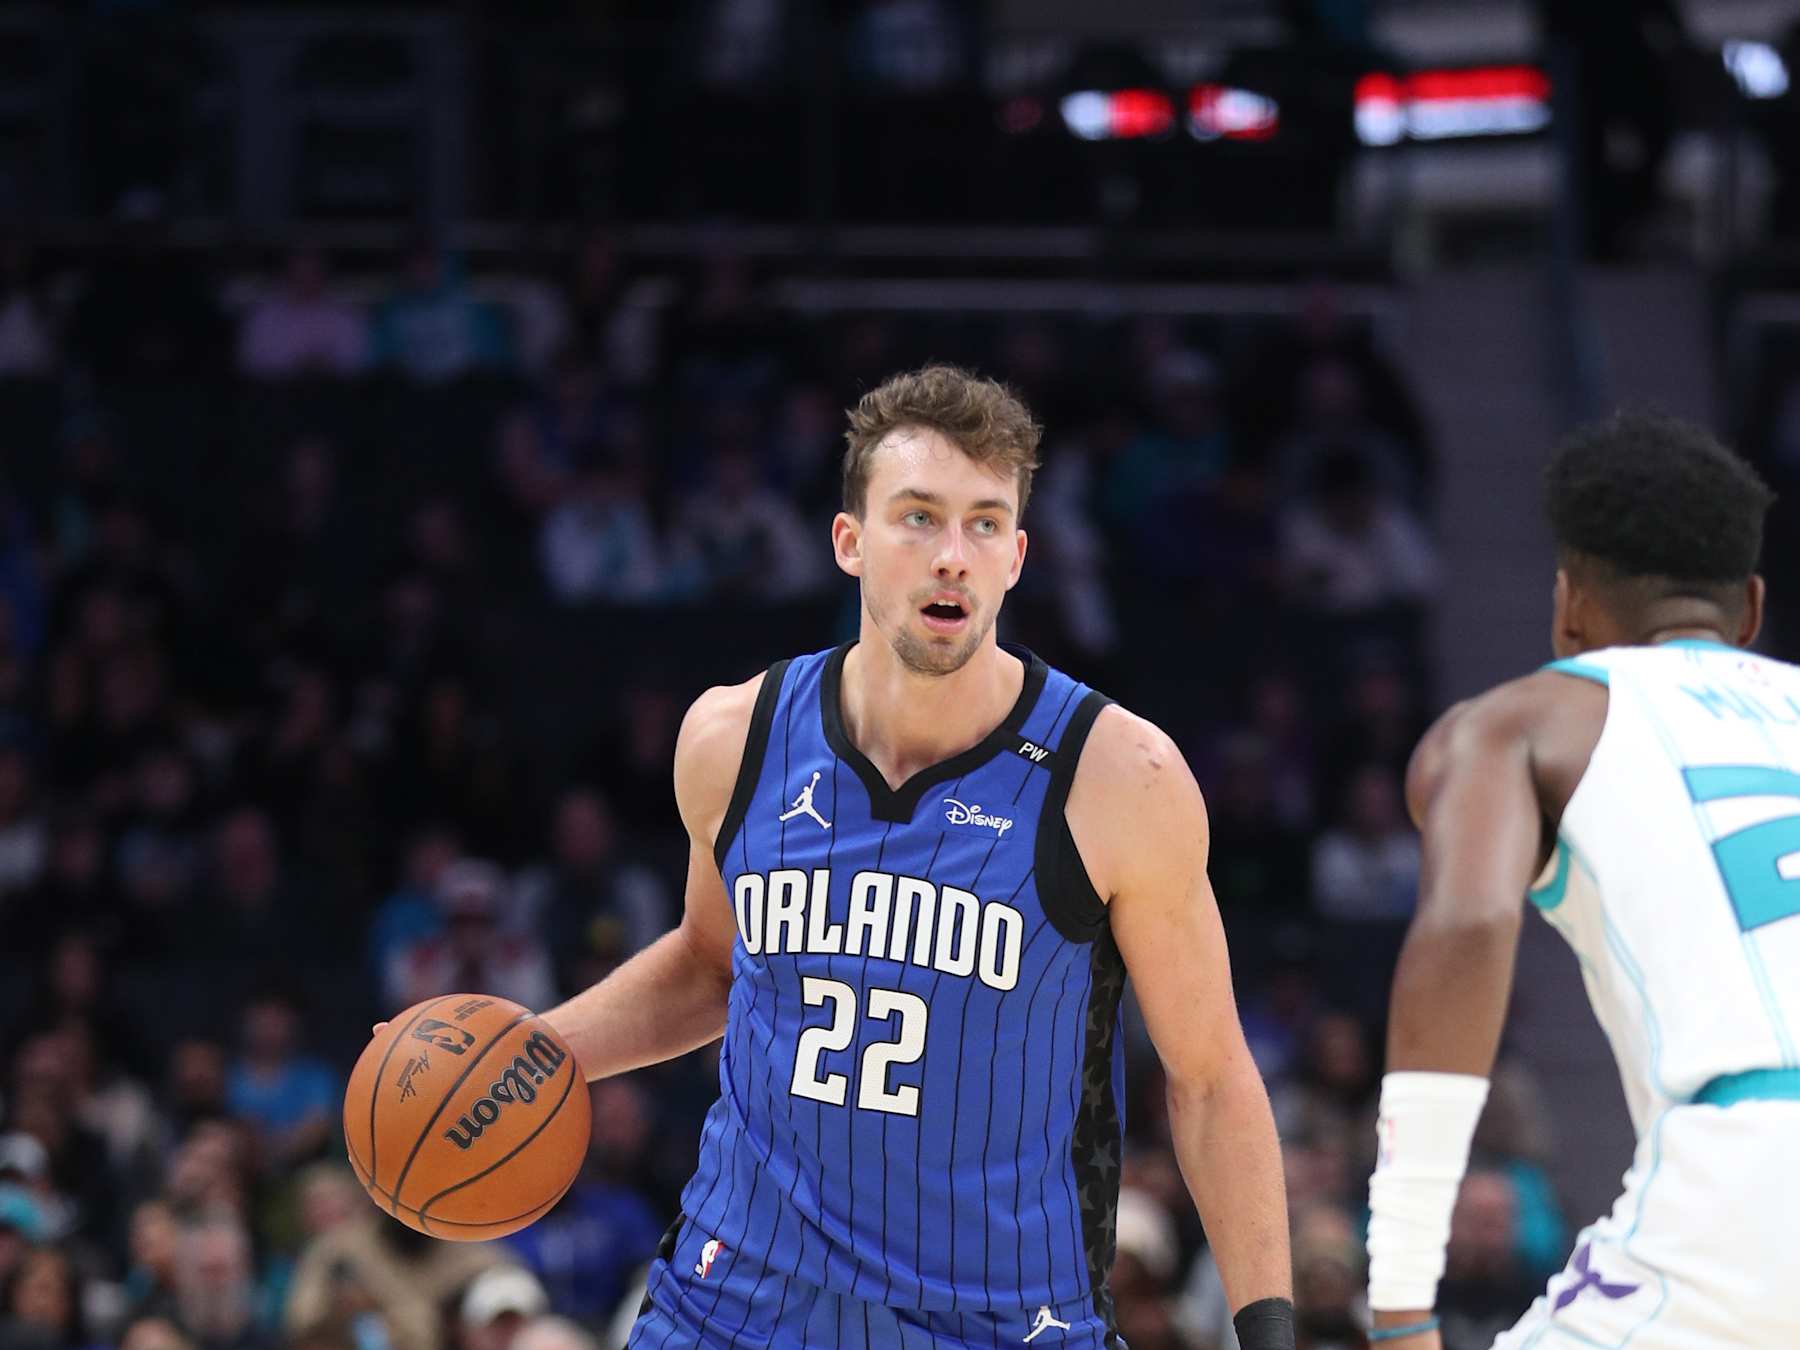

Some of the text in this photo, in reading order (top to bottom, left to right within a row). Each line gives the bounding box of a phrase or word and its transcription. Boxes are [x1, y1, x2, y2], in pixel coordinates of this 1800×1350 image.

[1018, 742, 1049, 762] PW
[734, 868, 1024, 992] ORLANDO
[444, 1030, 567, 1150] Wilson
[790, 976, 929, 1117] 22
